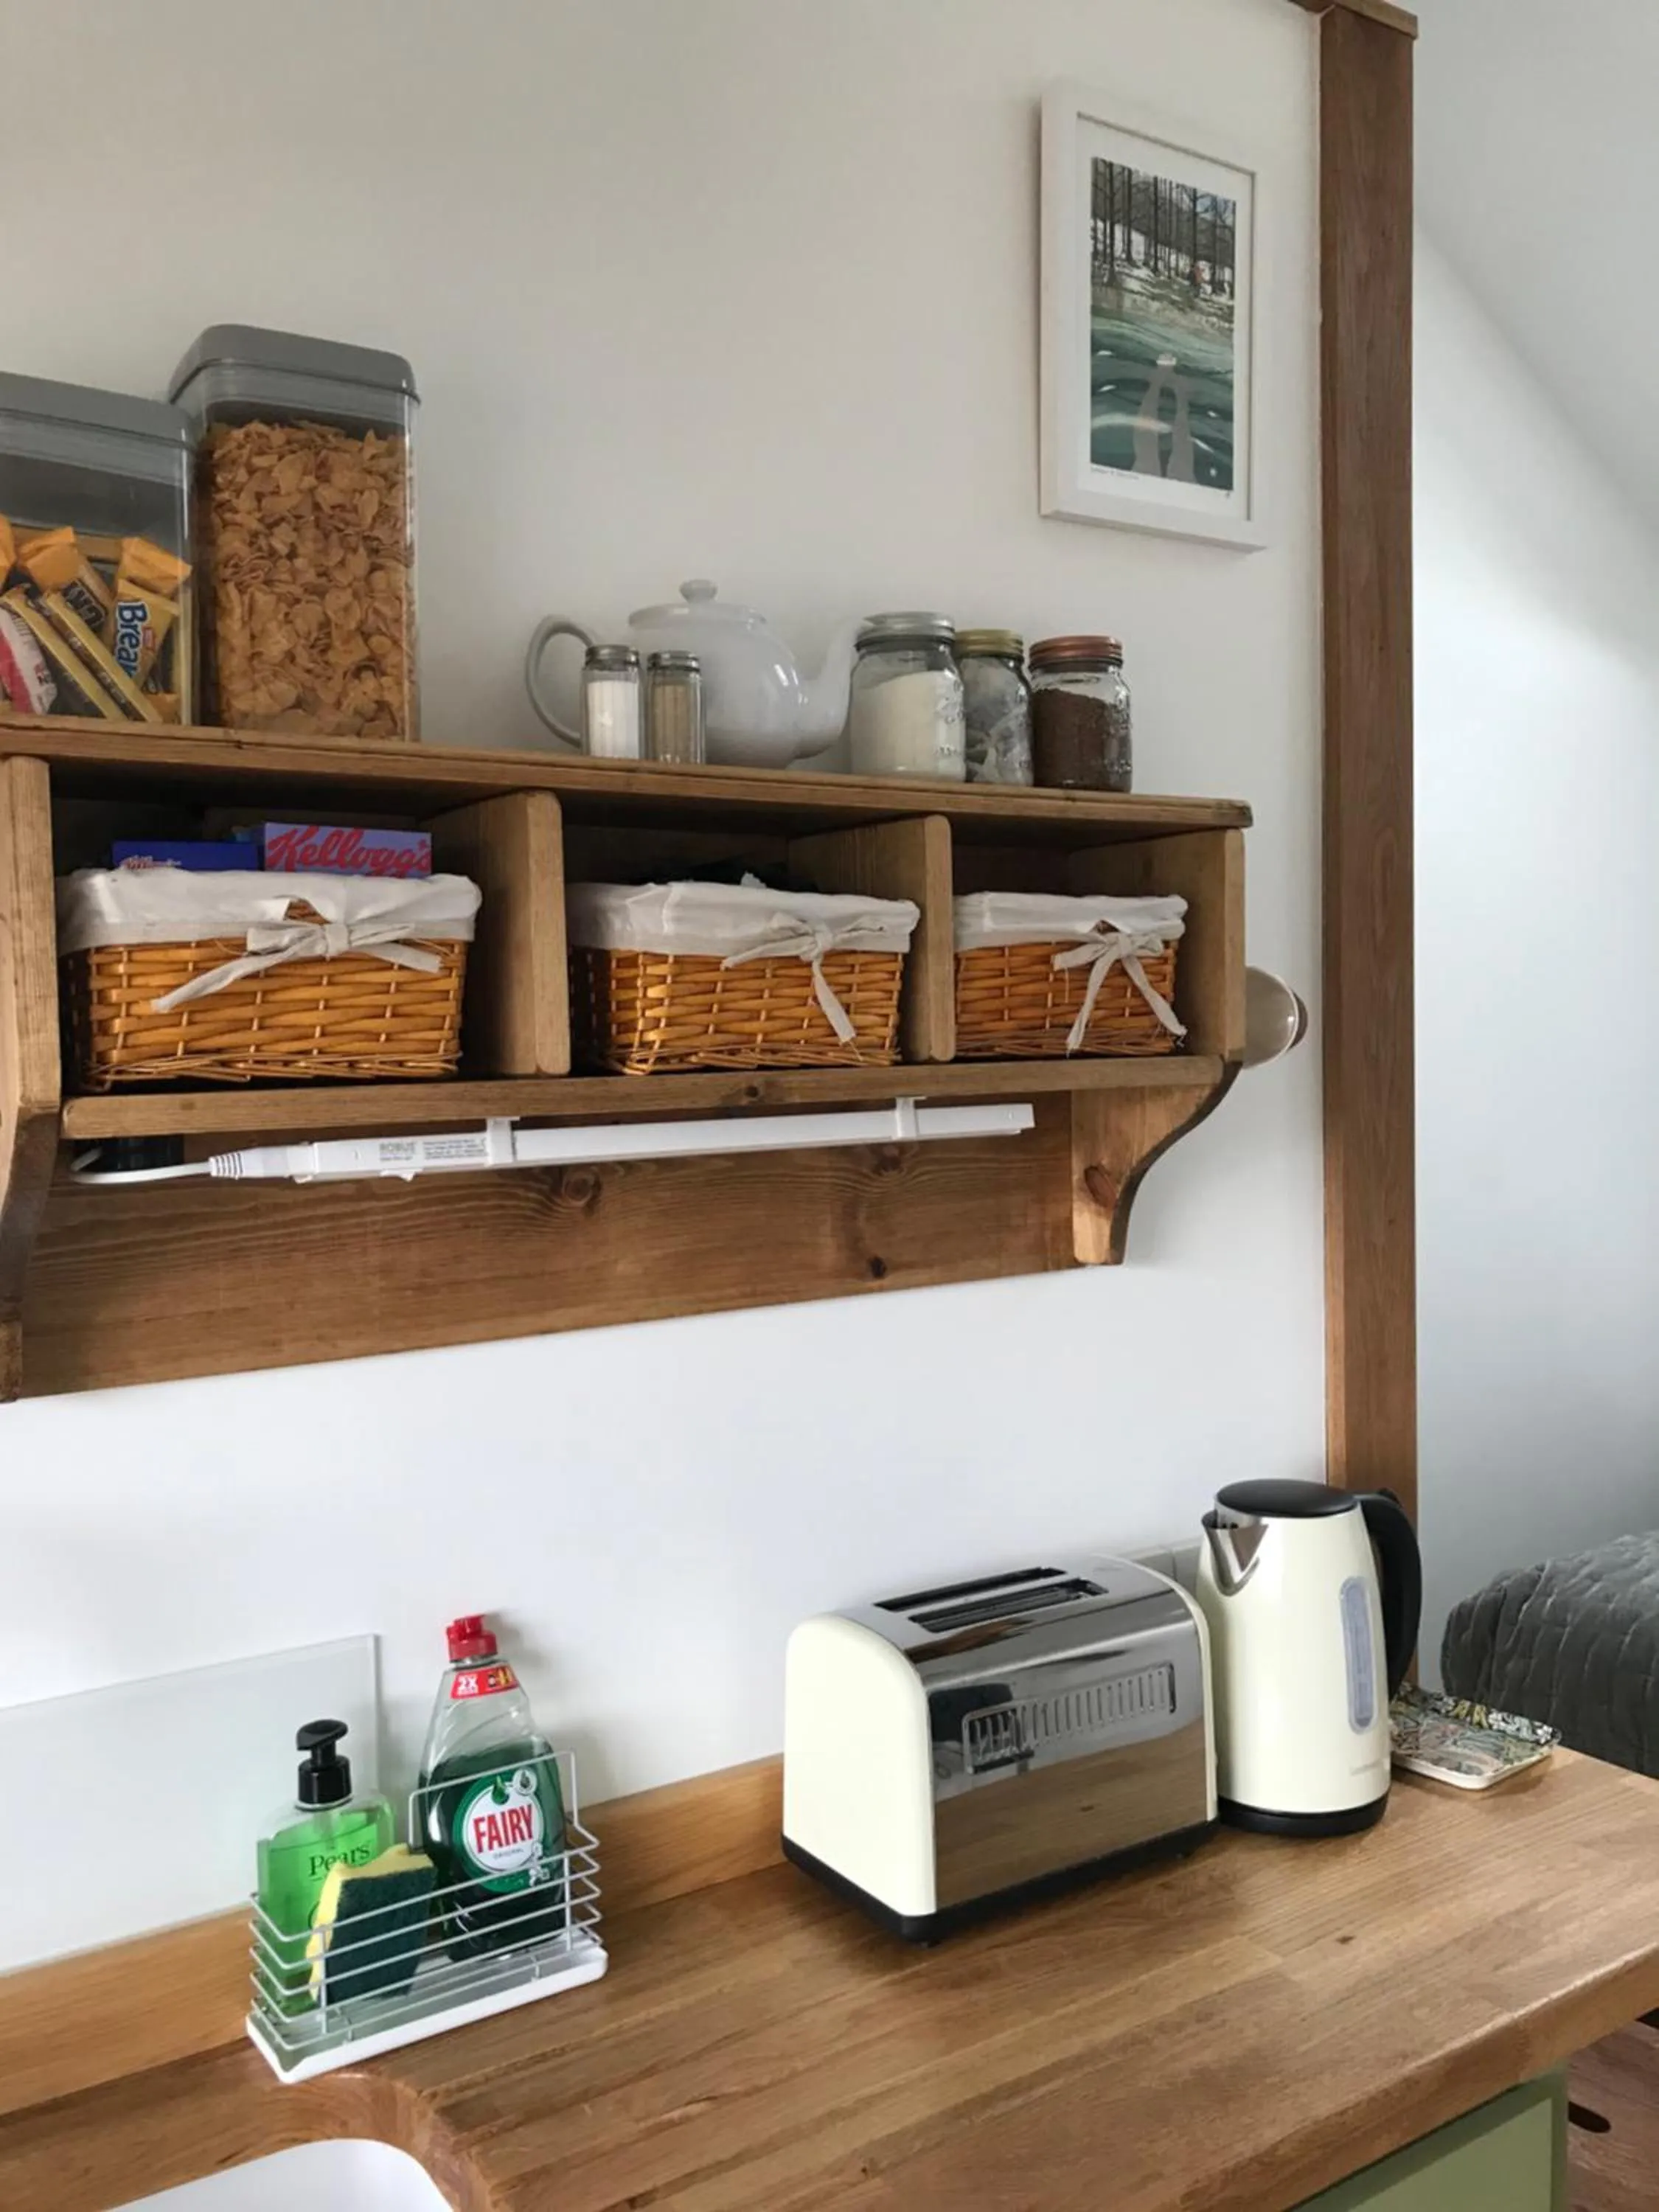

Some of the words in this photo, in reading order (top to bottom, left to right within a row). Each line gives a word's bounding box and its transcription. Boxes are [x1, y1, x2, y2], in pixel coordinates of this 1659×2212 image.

[267, 826, 431, 877] Kellogg's
[473, 1804, 533, 1854] FAIRY
[308, 1846, 370, 1877] Pears
